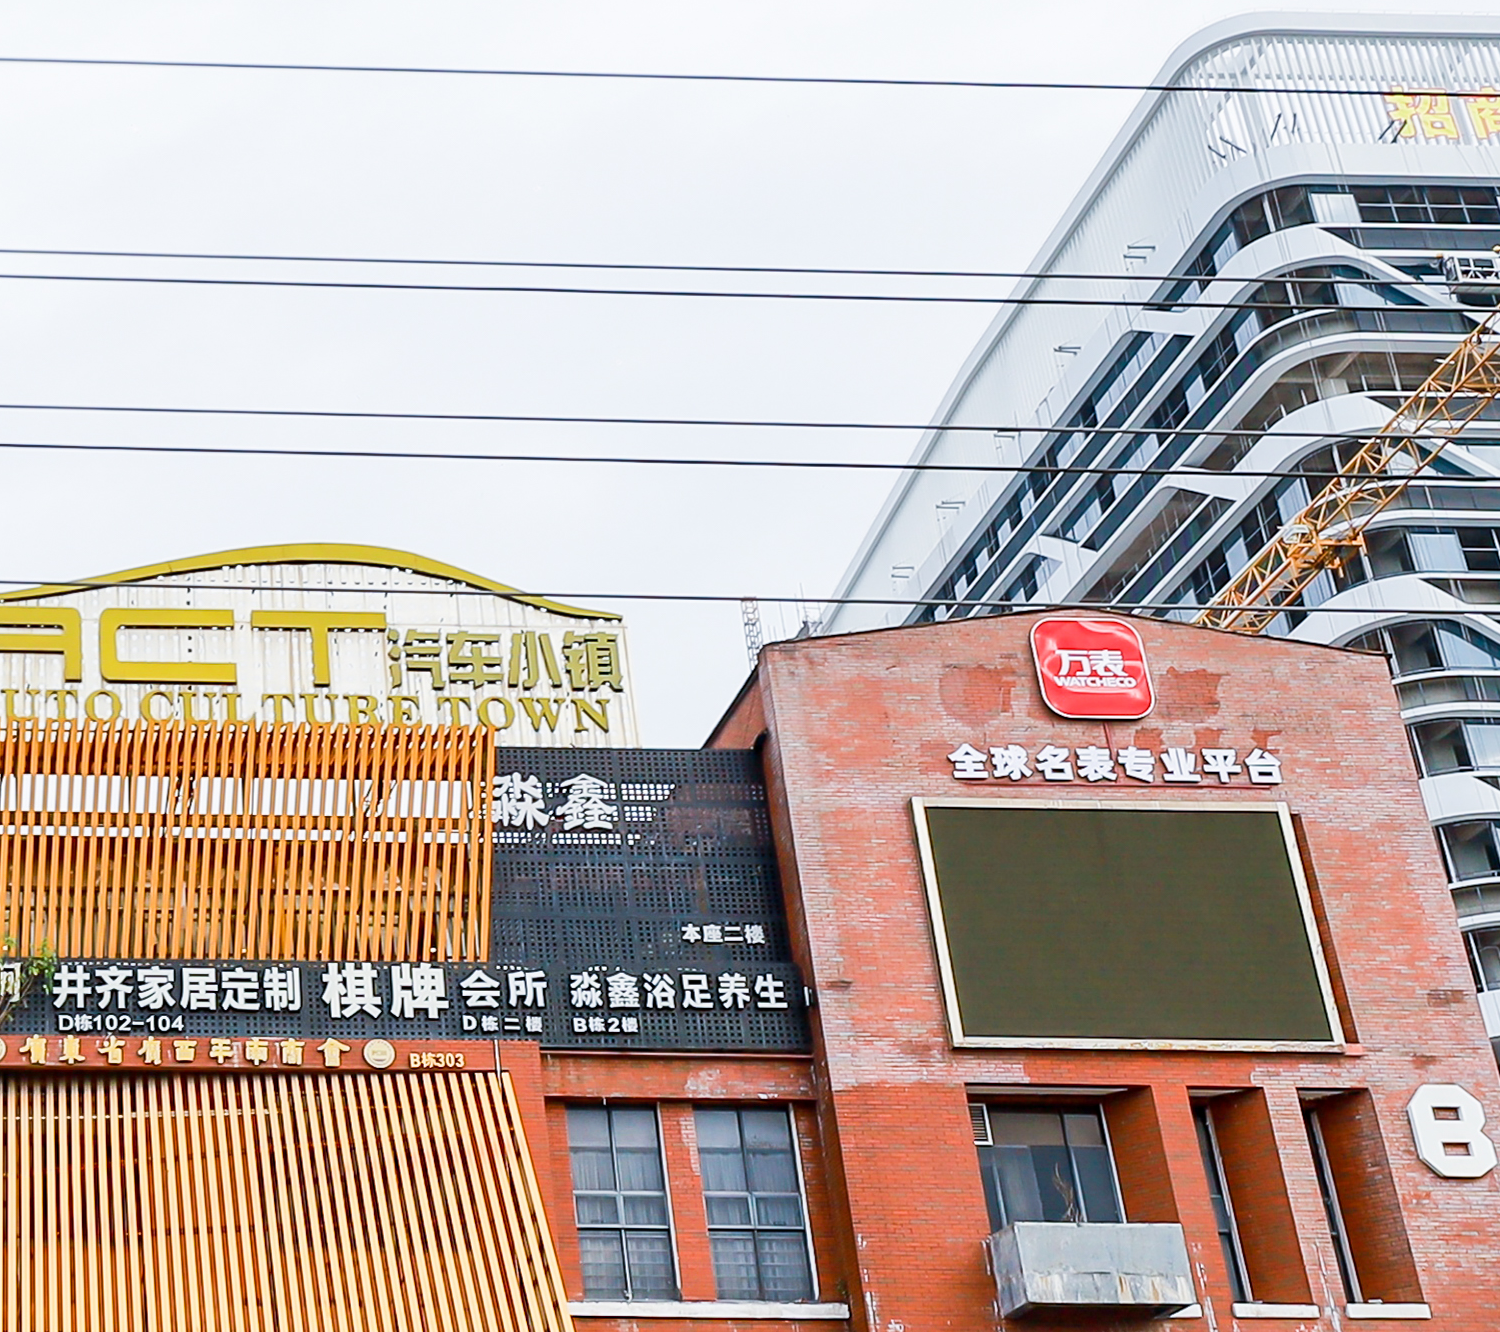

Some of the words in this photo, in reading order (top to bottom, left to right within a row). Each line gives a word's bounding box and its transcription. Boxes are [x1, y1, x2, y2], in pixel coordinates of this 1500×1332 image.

[386, 628, 625, 692] 汽车小镇
[1054, 648, 1129, 677] 万表
[1053, 675, 1137, 689] WATCHECO
[438, 695, 612, 732] TOWN
[947, 743, 1283, 785] 全球名表专业平台
[681, 923, 766, 946] 本座二楼
[52, 966, 302, 1012] 井齐家居定制
[570, 972, 789, 1010] 淼鑫浴足养生
[573, 1015, 639, 1035] B栋2楼
[409, 1051, 465, 1069] B栋303
[1406, 1083, 1498, 1179] B
